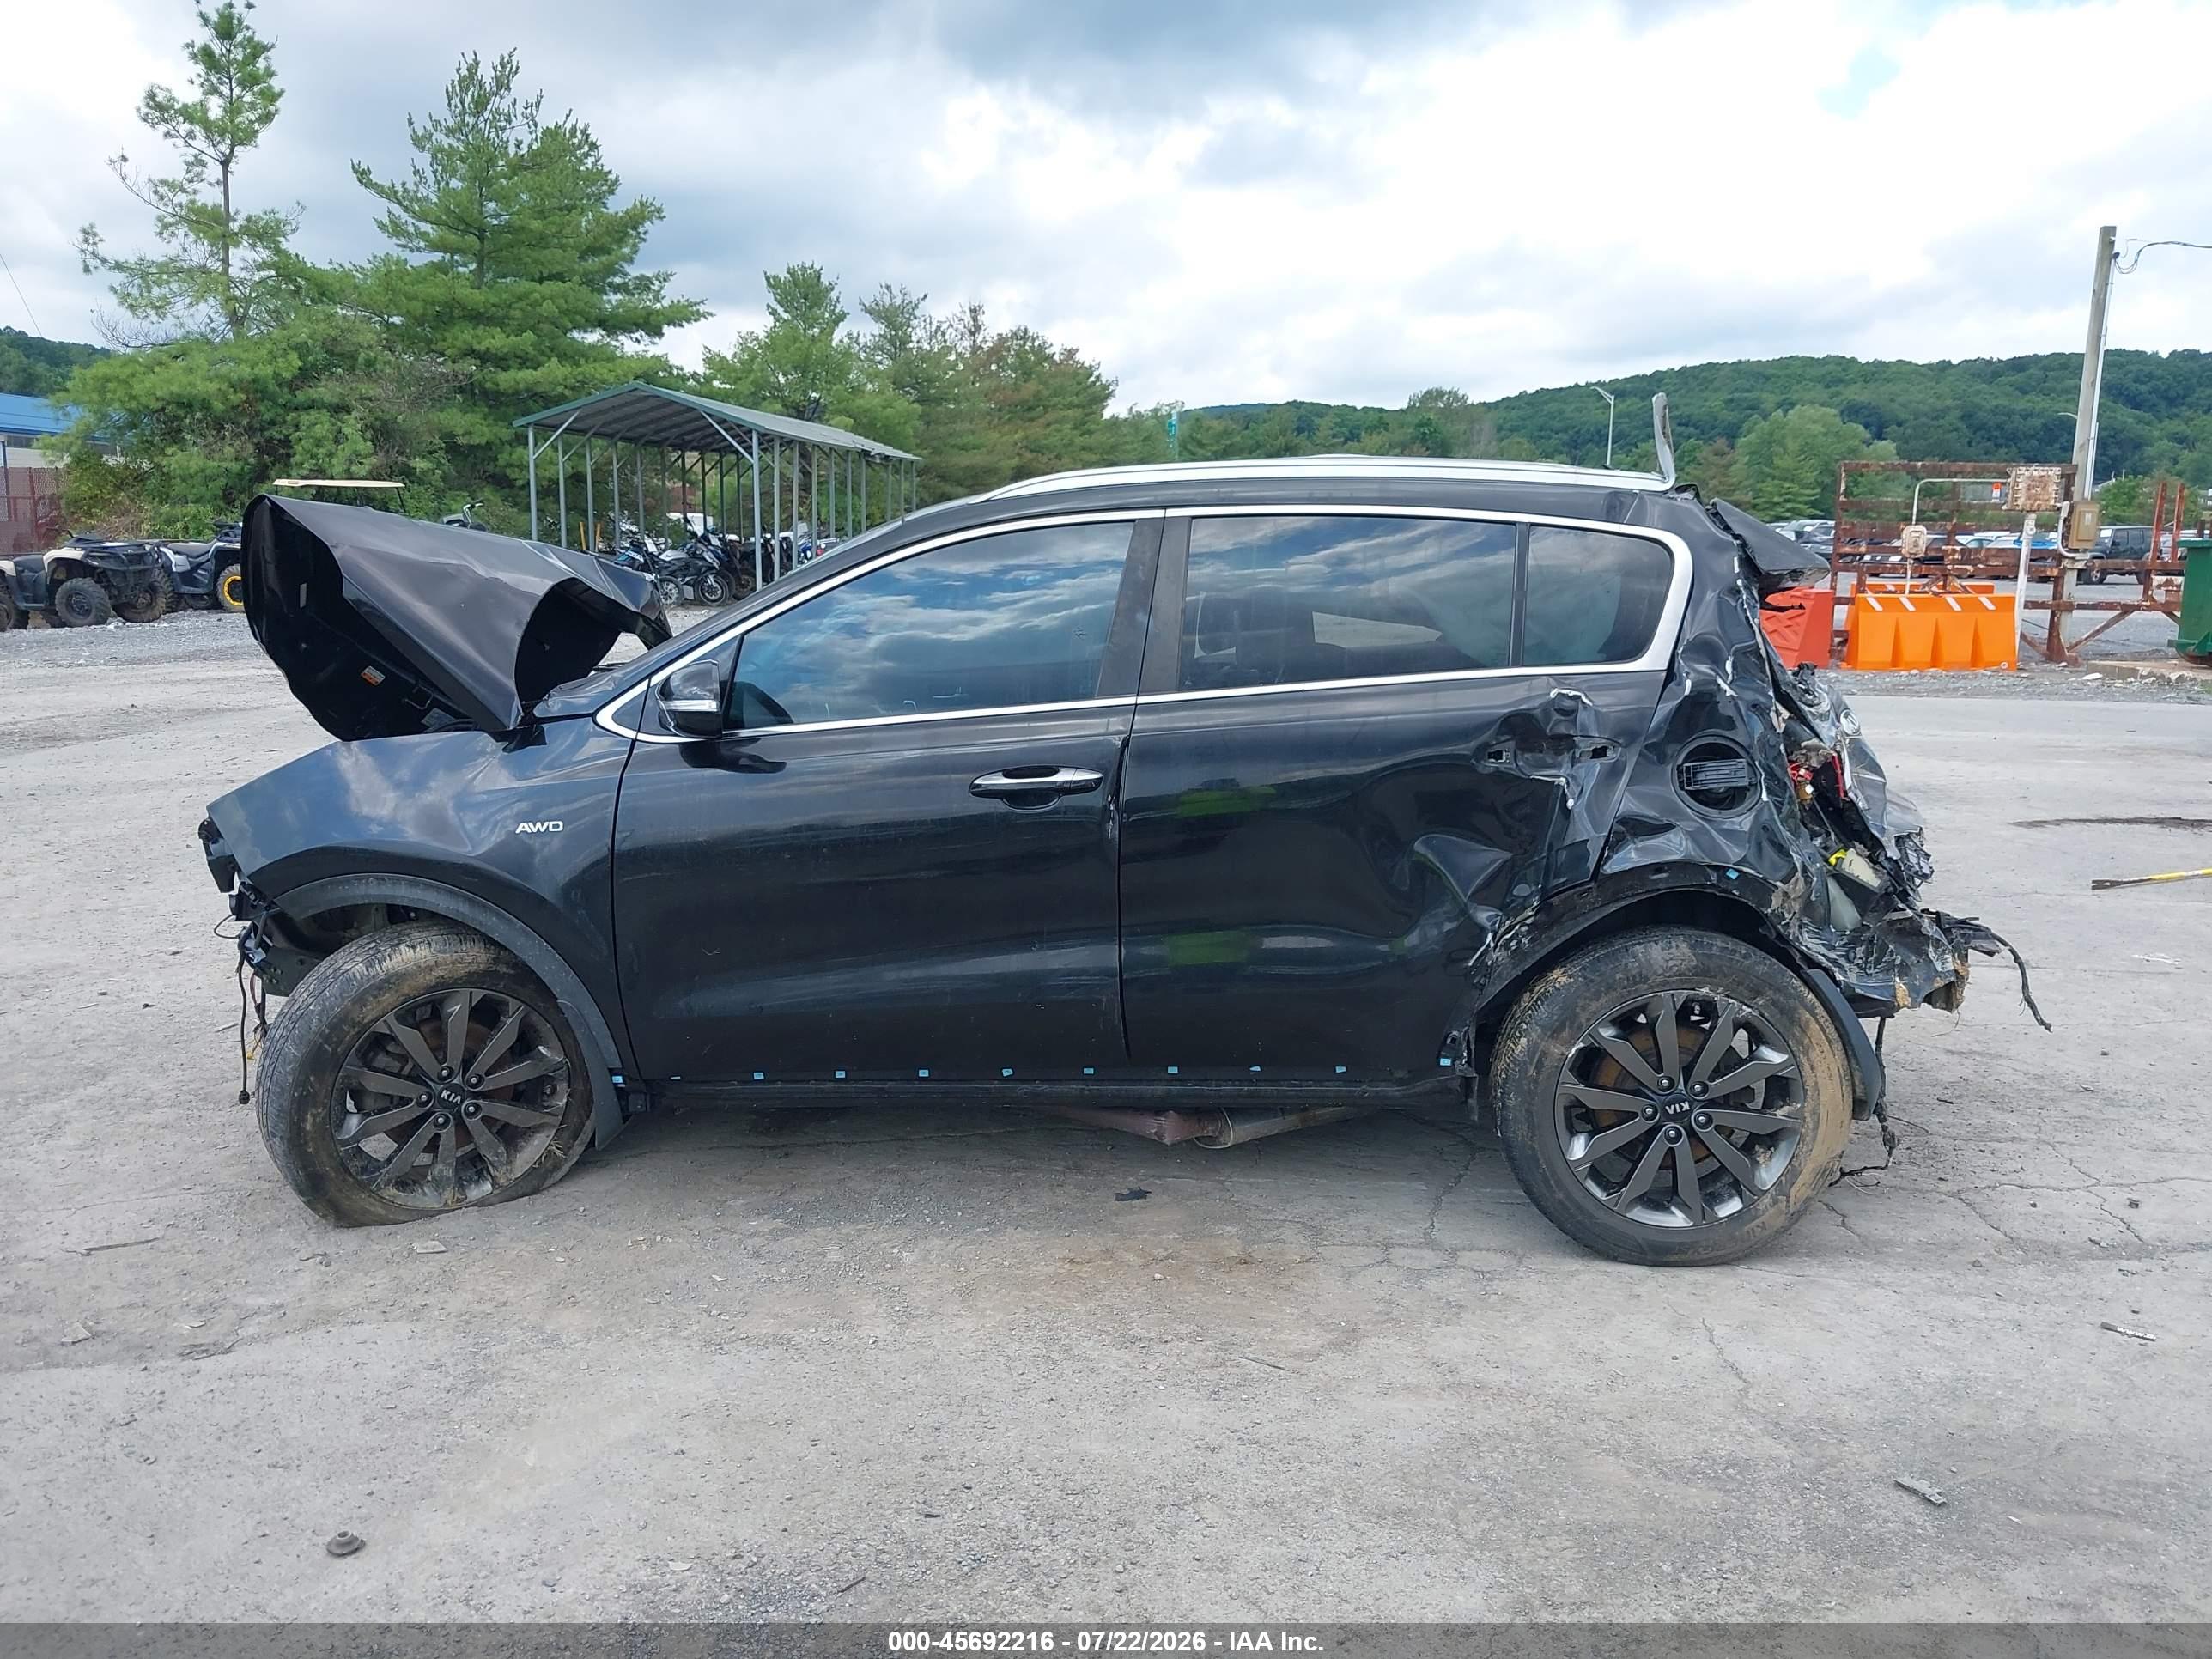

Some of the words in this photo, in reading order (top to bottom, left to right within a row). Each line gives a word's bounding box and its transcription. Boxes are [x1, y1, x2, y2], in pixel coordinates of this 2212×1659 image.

[515, 820, 563, 834] AWD
[441, 1089, 462, 1105] KIA
[1665, 1101, 1691, 1115] KIA
